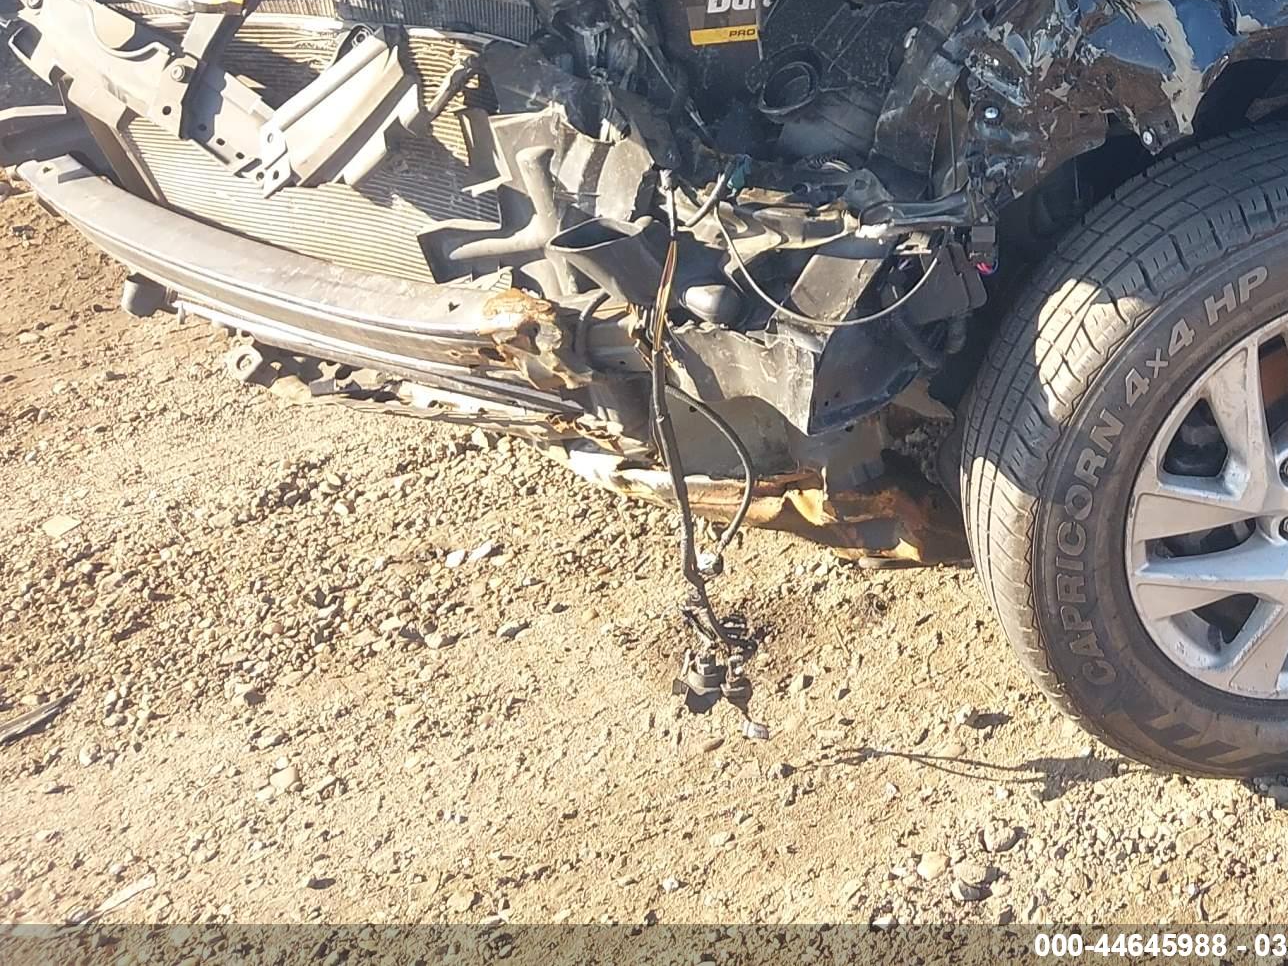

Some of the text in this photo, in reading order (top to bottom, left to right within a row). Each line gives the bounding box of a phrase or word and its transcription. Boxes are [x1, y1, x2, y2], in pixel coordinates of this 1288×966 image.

[729, 28, 757, 38] PRO
[1056, 409, 1125, 685] CAPRICORN
[1204, 265, 1268, 326] HP
